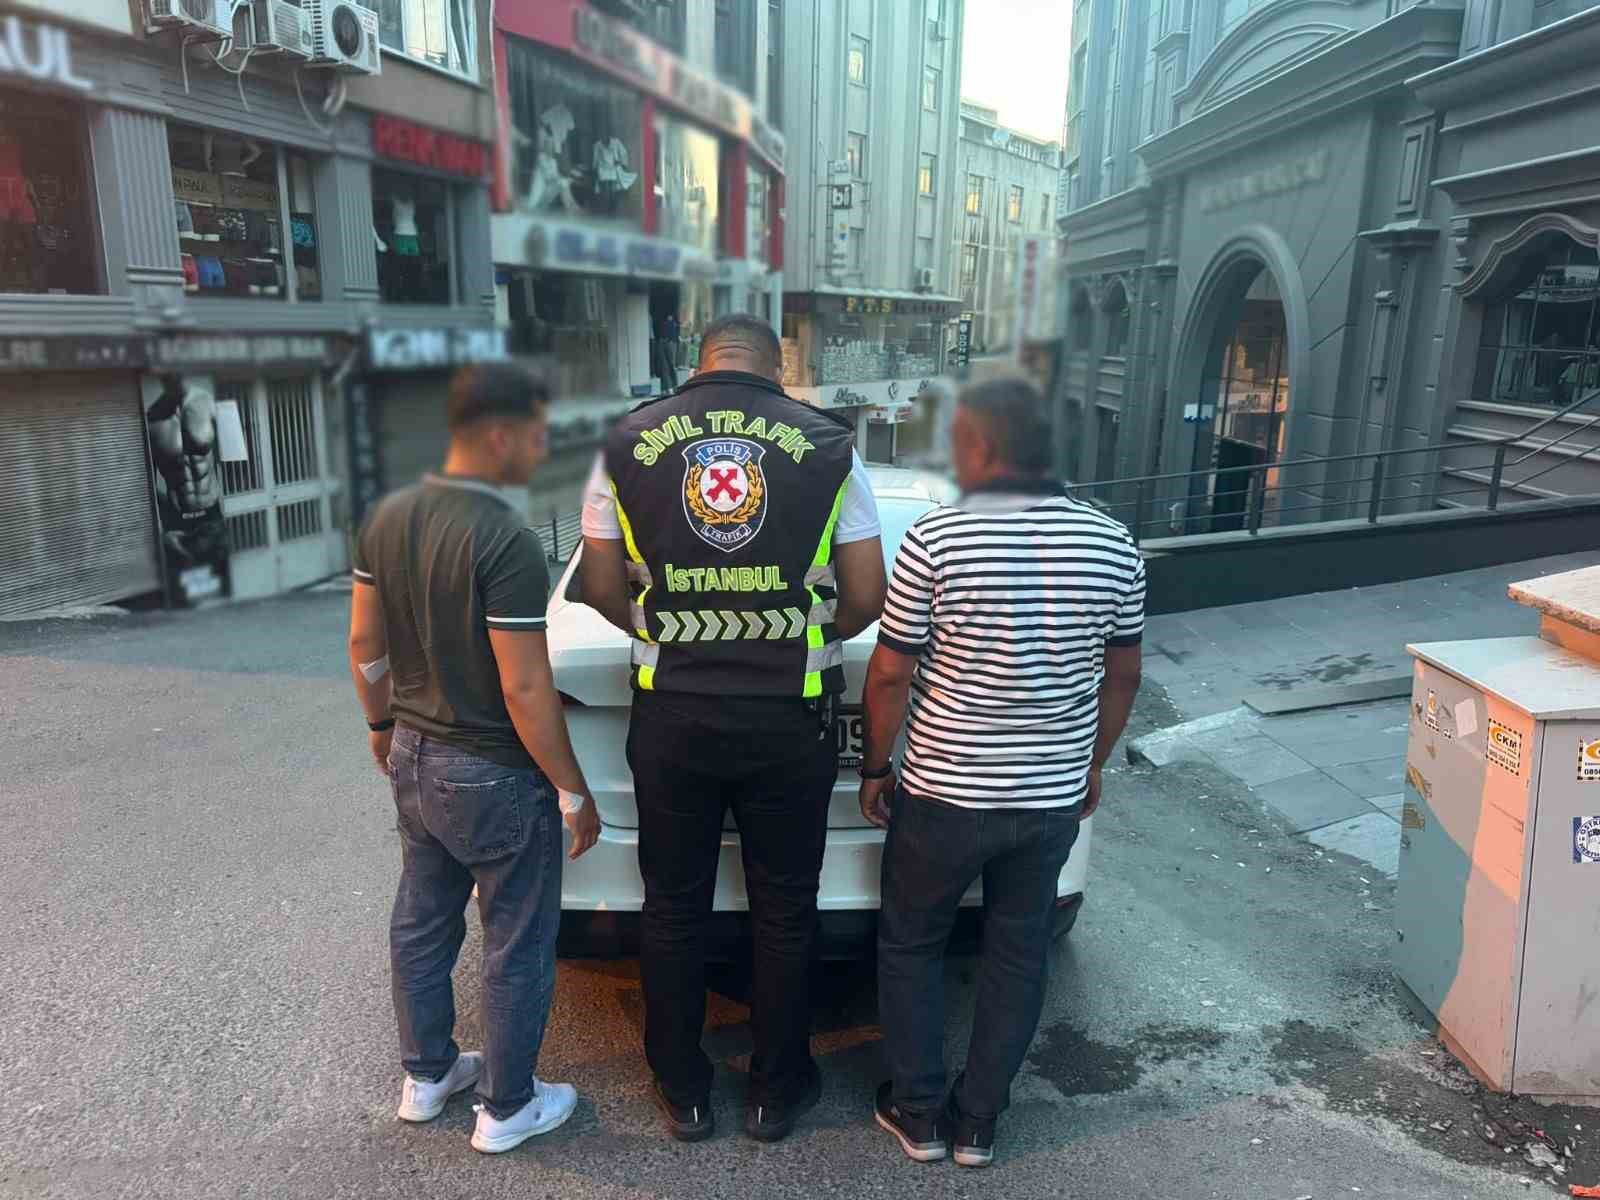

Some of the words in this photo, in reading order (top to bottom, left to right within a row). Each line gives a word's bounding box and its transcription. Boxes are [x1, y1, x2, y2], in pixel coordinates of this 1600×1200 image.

[633, 415, 703, 466] SİVİL
[706, 410, 816, 464] TRAFİK
[706, 442, 742, 456] POLİS
[664, 564, 788, 592] İSTANBUL
[1496, 732, 1518, 748] CKM
